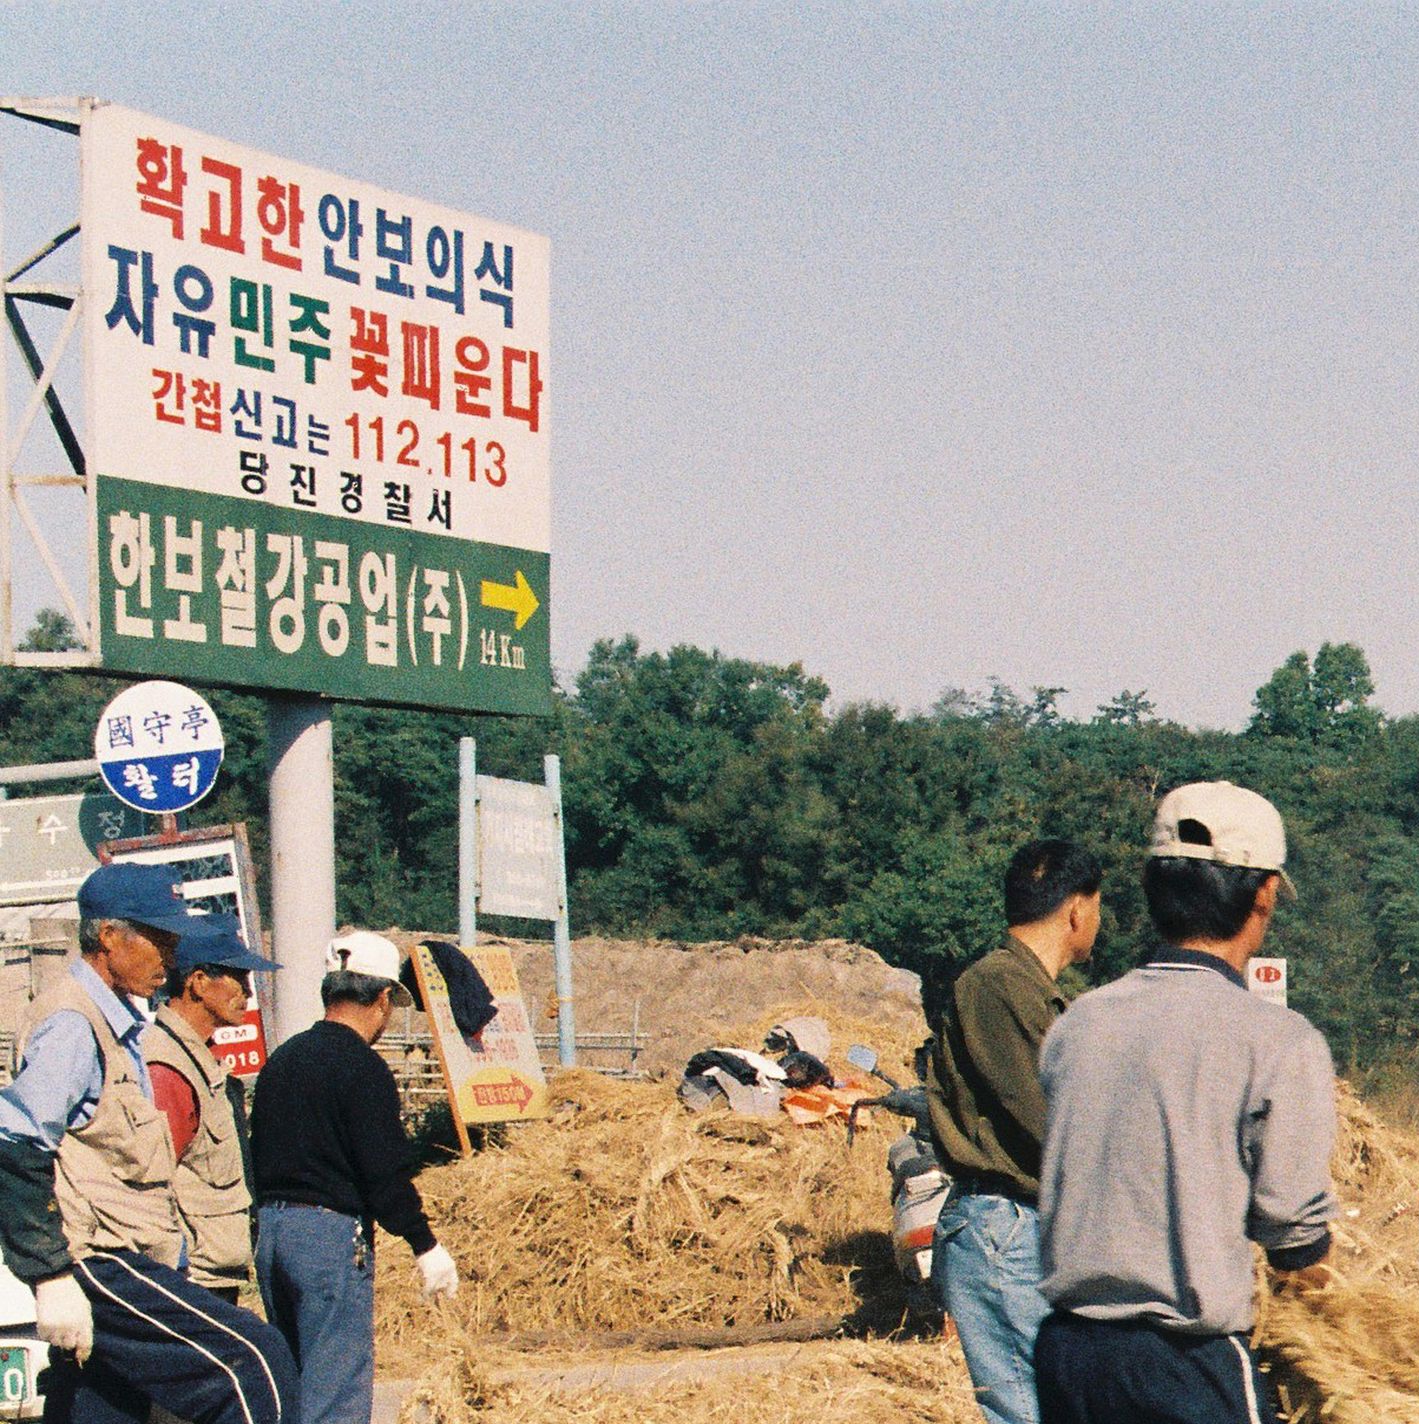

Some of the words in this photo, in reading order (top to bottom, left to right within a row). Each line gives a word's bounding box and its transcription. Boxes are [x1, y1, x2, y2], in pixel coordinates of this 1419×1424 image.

[136, 136, 303, 272] 확고한
[318, 192, 514, 329] 안보의식
[105, 245, 331, 385] 자유민주
[349, 306, 543, 433] 꽃피운다
[107, 705, 208, 749] 國守亭
